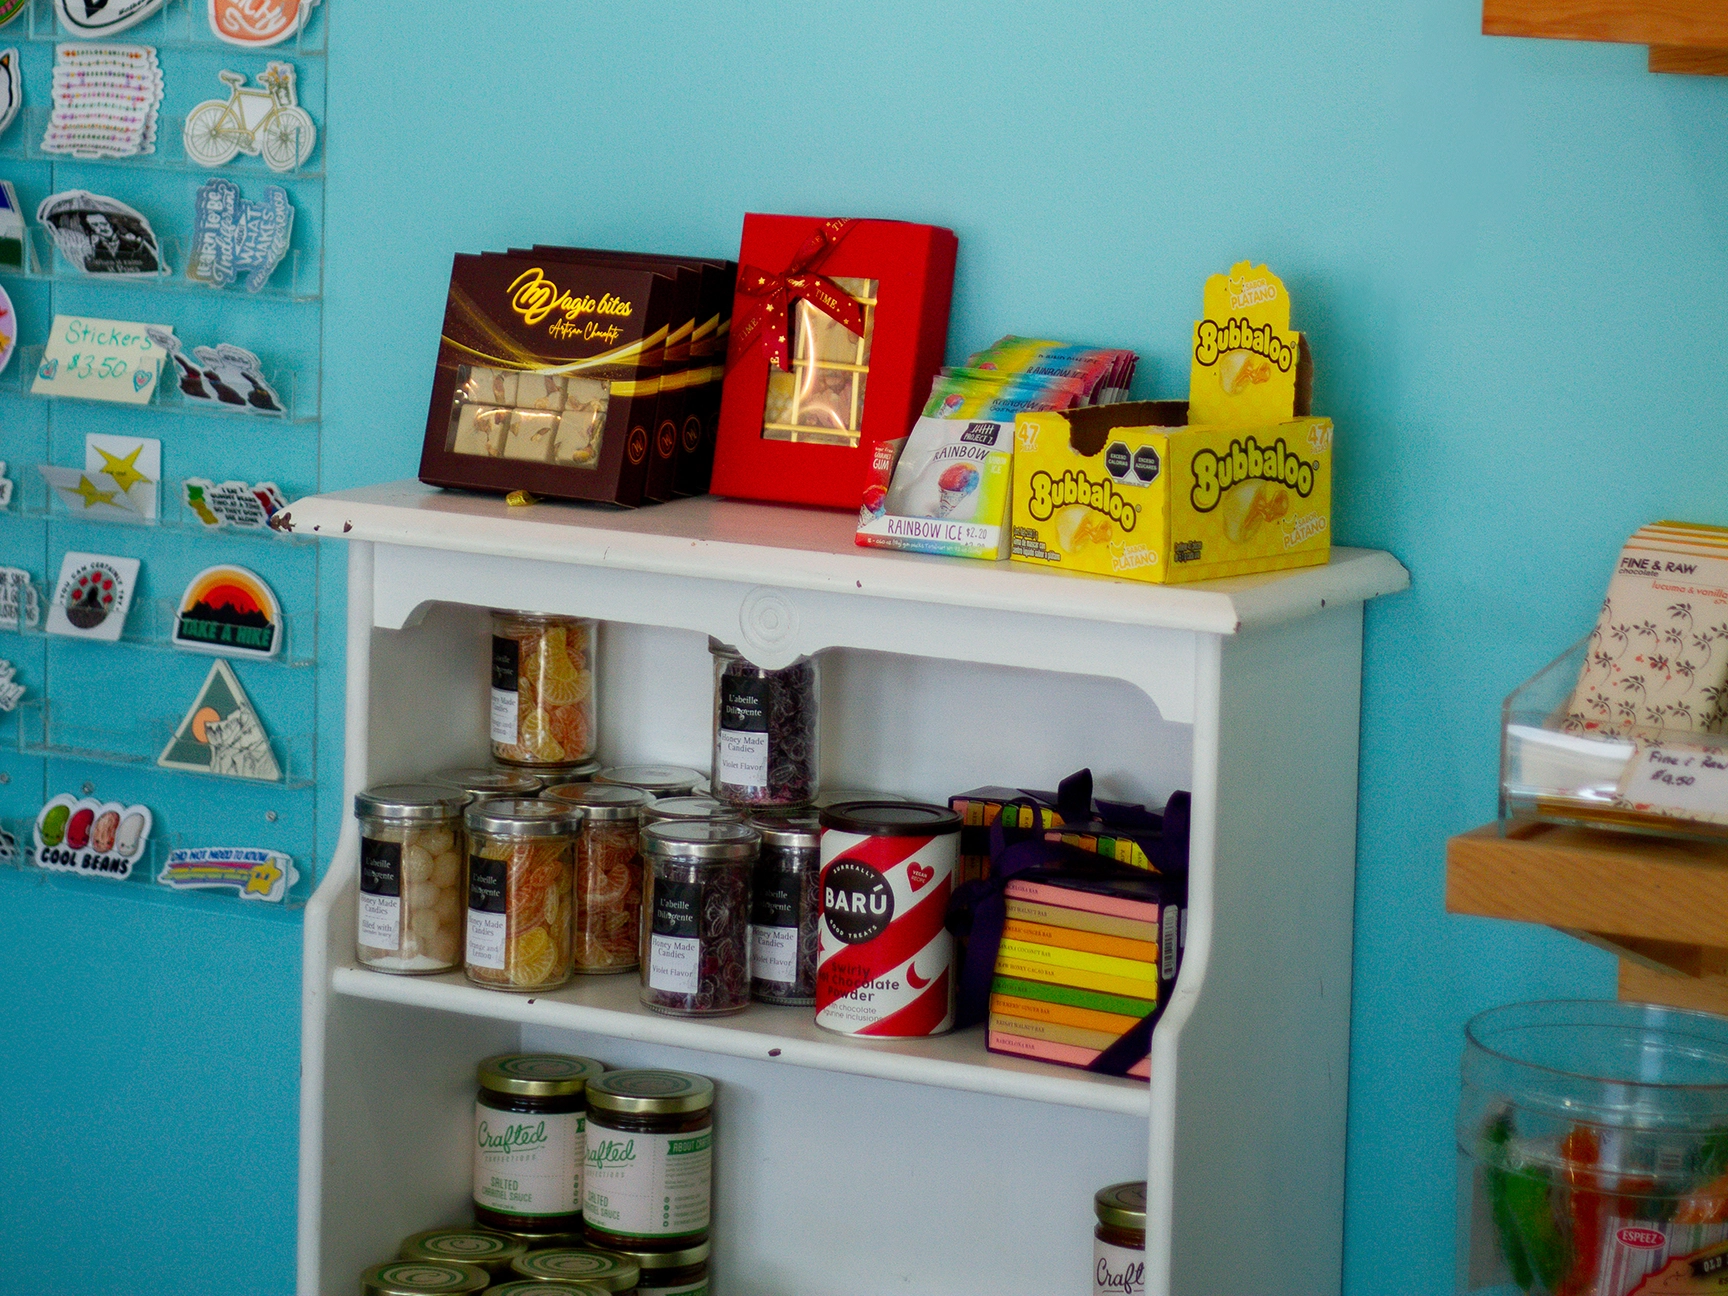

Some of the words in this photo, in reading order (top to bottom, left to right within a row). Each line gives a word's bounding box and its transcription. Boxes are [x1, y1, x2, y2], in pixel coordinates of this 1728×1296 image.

[596, 293, 633, 317] bites
[65, 320, 152, 350] Stickers
[1196, 317, 1293, 373] Bubbaloo
[1018, 421, 1040, 445] 47
[933, 445, 990, 461] RAINBOW
[873, 458, 889, 470] GUM
[1190, 435, 1314, 513] Bubbaloo
[1028, 469, 1136, 532] Bubbaloo
[888, 518, 942, 539] RAINBOW
[945, 524, 962, 541] ICE
[966, 527, 988, 540] $2.20
[1618, 568, 1659, 577] chocolate
[1620, 557, 1650, 569] FINE
[1651, 561, 1661, 571] &
[1665, 561, 1698, 575] RAW
[182, 618, 217, 639] TAKE
[221, 624, 232, 642] A
[236, 626, 271, 647] HIKE
[727, 742, 755, 753] Candies
[743, 736, 765, 746] Made
[740, 762, 763, 771] Flavor
[41, 847, 77, 867] COOL
[81, 854, 129, 875] BEANS
[832, 864, 875, 879] SURREALLY
[912, 870, 928, 878] VEGAN
[660, 898, 690, 910] L'abeille
[825, 884, 887, 915] BARÚ
[773, 931, 794, 941] Made
[829, 919, 845, 936] GOOD
[848, 924, 878, 939] TREATS
[652, 937, 672, 950] Honey
[673, 941, 696, 952] Made
[757, 937, 784, 948] Candies
[658, 947, 686, 959] Candies
[670, 968, 693, 977] Flavor
[831, 961, 871, 980] Swirly
[832, 974, 900, 991] Chocolate
[827, 985, 876, 1002] Powder
[838, 1003, 877, 1015] chocolate
[477, 1120, 548, 1154] Crafted
[586, 1139, 636, 1169] rafted
[491, 1176, 519, 1191] SALTED
[509, 1192, 533, 1203] SAUCE
[1622, 1230, 1658, 1244] ESPEEZ
[1703, 1256, 1722, 1273] OLD
